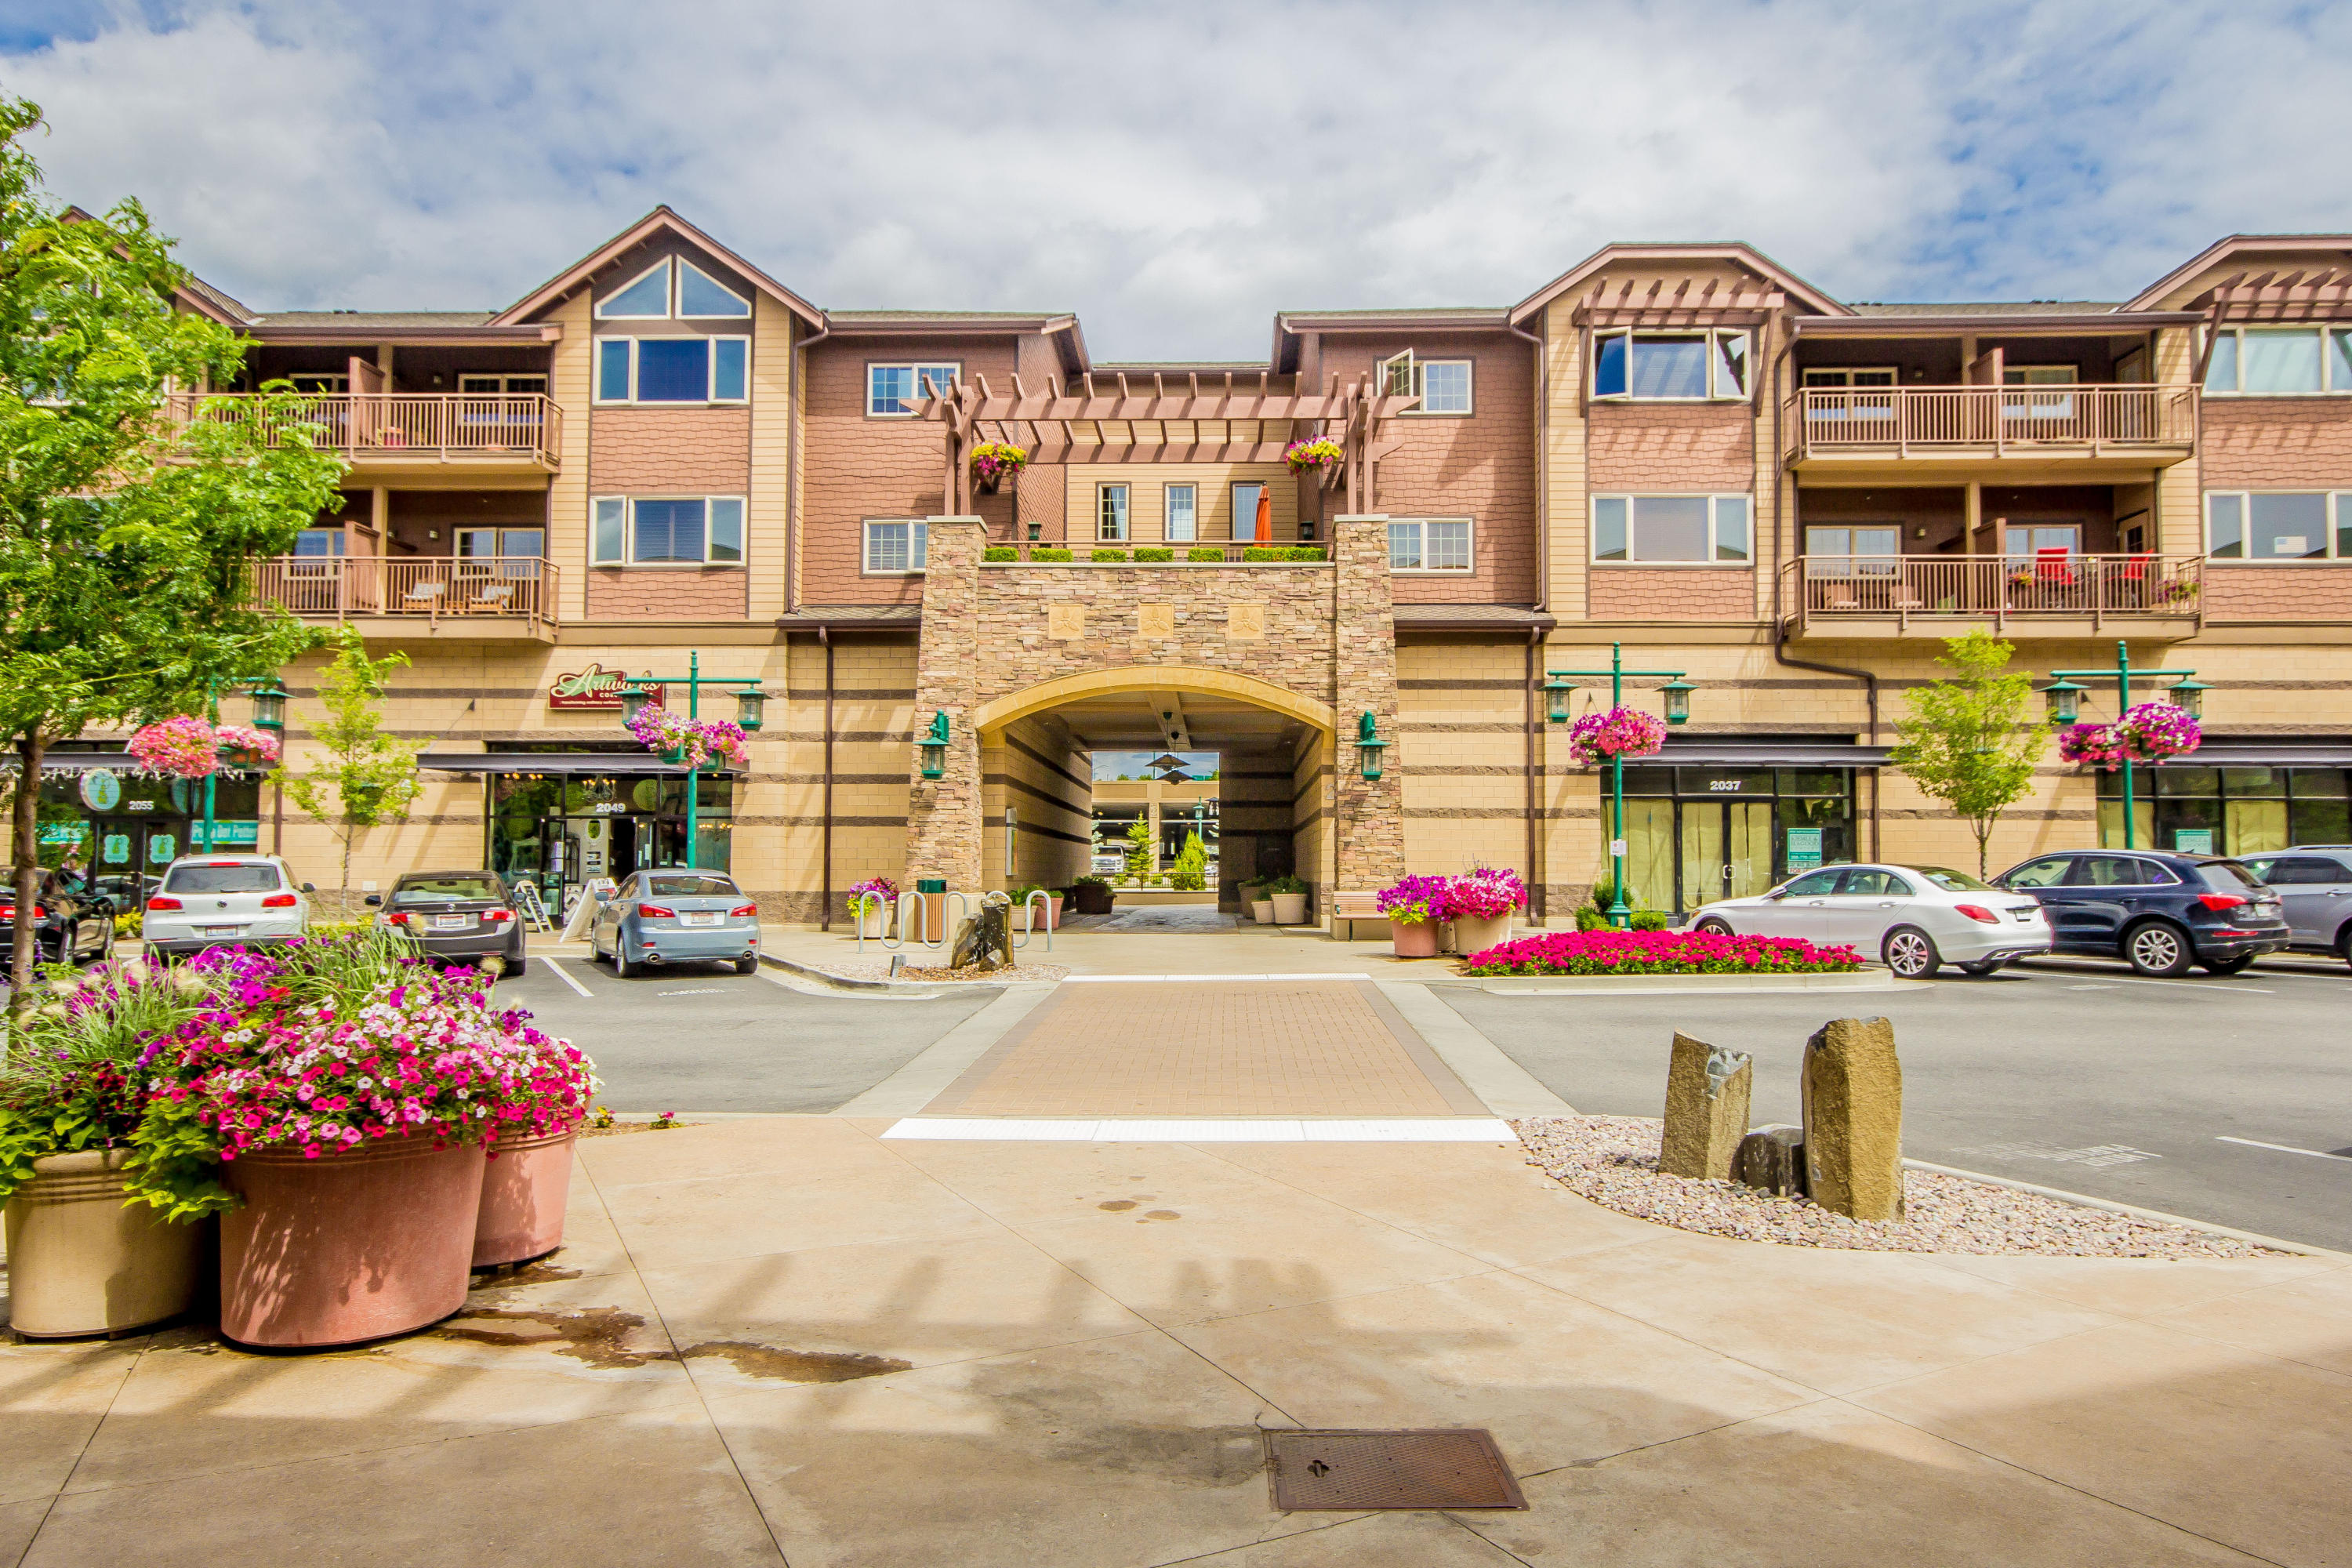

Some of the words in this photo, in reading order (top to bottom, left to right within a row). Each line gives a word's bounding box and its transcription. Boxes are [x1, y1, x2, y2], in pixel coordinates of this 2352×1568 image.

[551, 663, 661, 697] Artwoks
[1710, 780, 1741, 790] 2037
[129, 800, 154, 810] 2055
[596, 803, 626, 812] 2049
